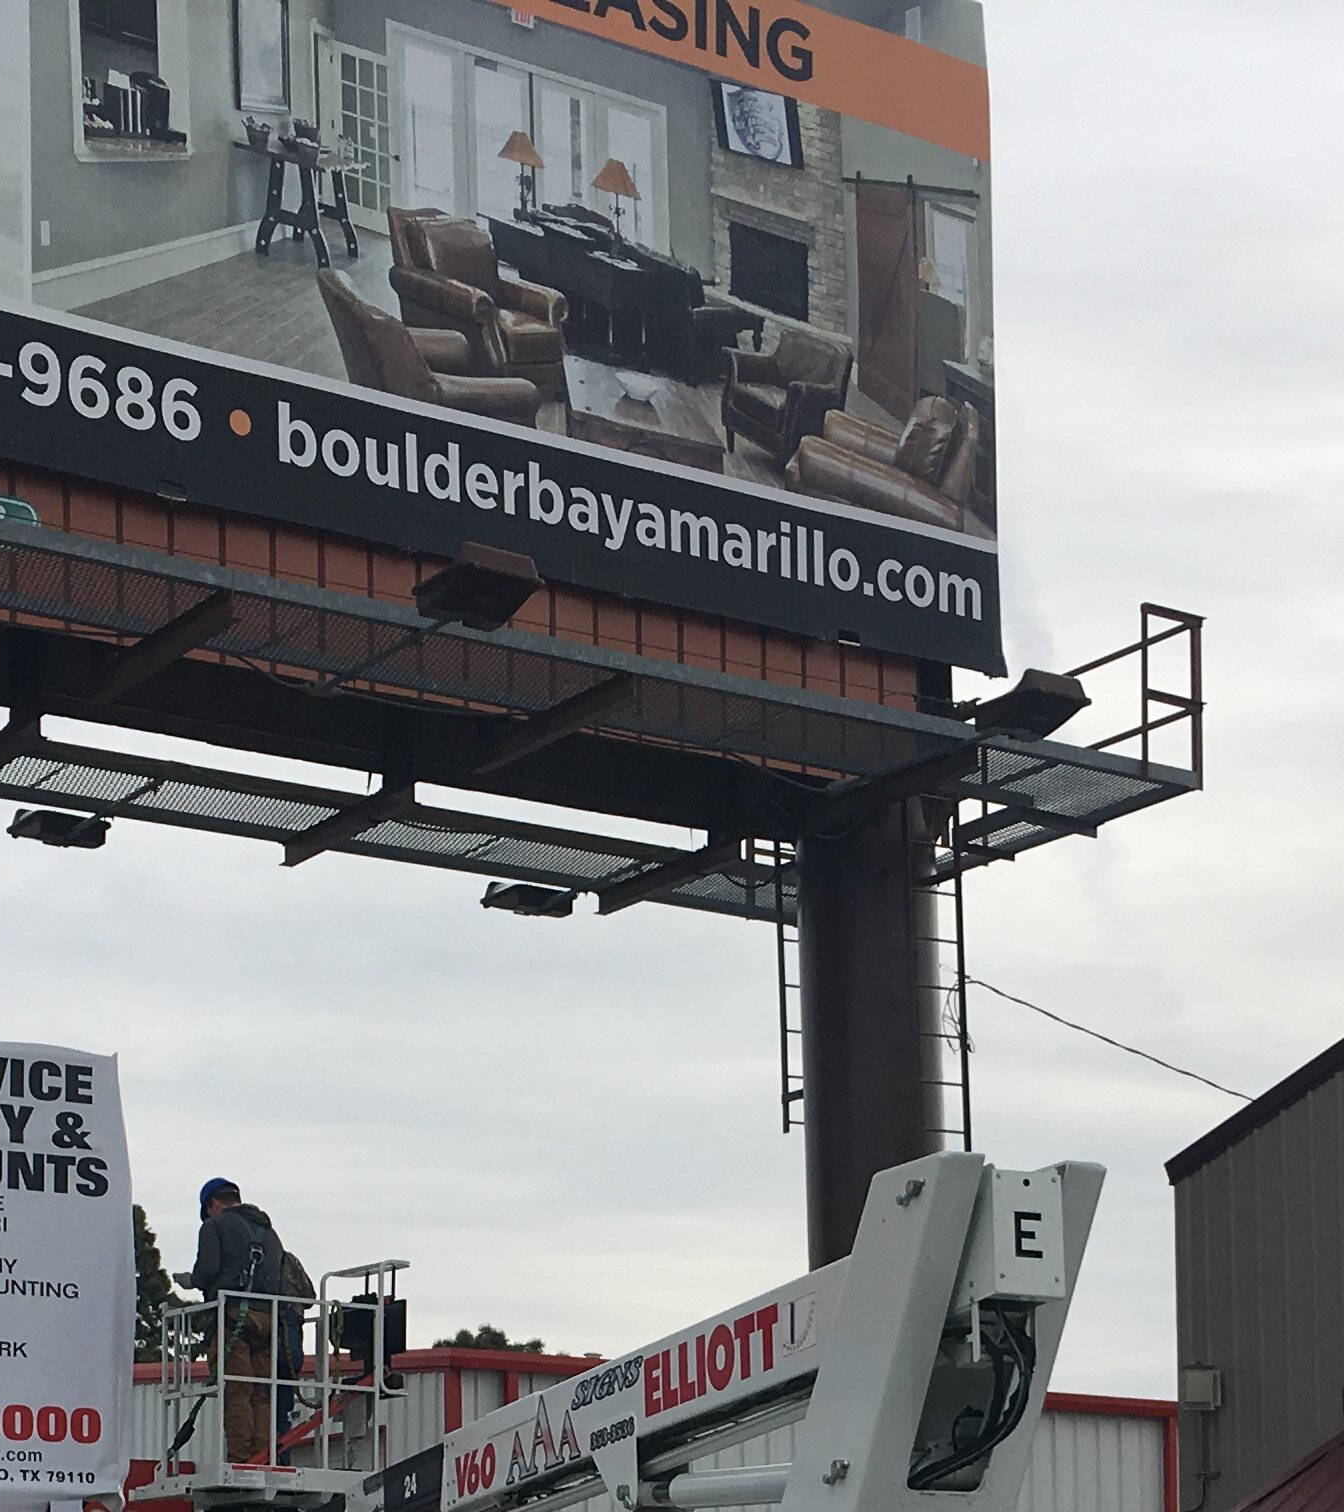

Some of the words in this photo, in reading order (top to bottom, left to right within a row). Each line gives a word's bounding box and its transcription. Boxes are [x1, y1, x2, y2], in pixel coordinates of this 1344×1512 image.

[277, 401, 983, 621] boulderbayamarillo.com
[51, 1111, 91, 1150] &
[1013, 1211, 1043, 1258] E
[571, 1354, 644, 1411] SIGNS
[644, 1302, 778, 1418] ELLIOTT
[506, 1394, 581, 1485] AAA
[20, 1469, 41, 1483] TX
[46, 1469, 96, 1485] 79110
[404, 1472, 417, 1499] 24
[455, 1442, 496, 1499] V60
